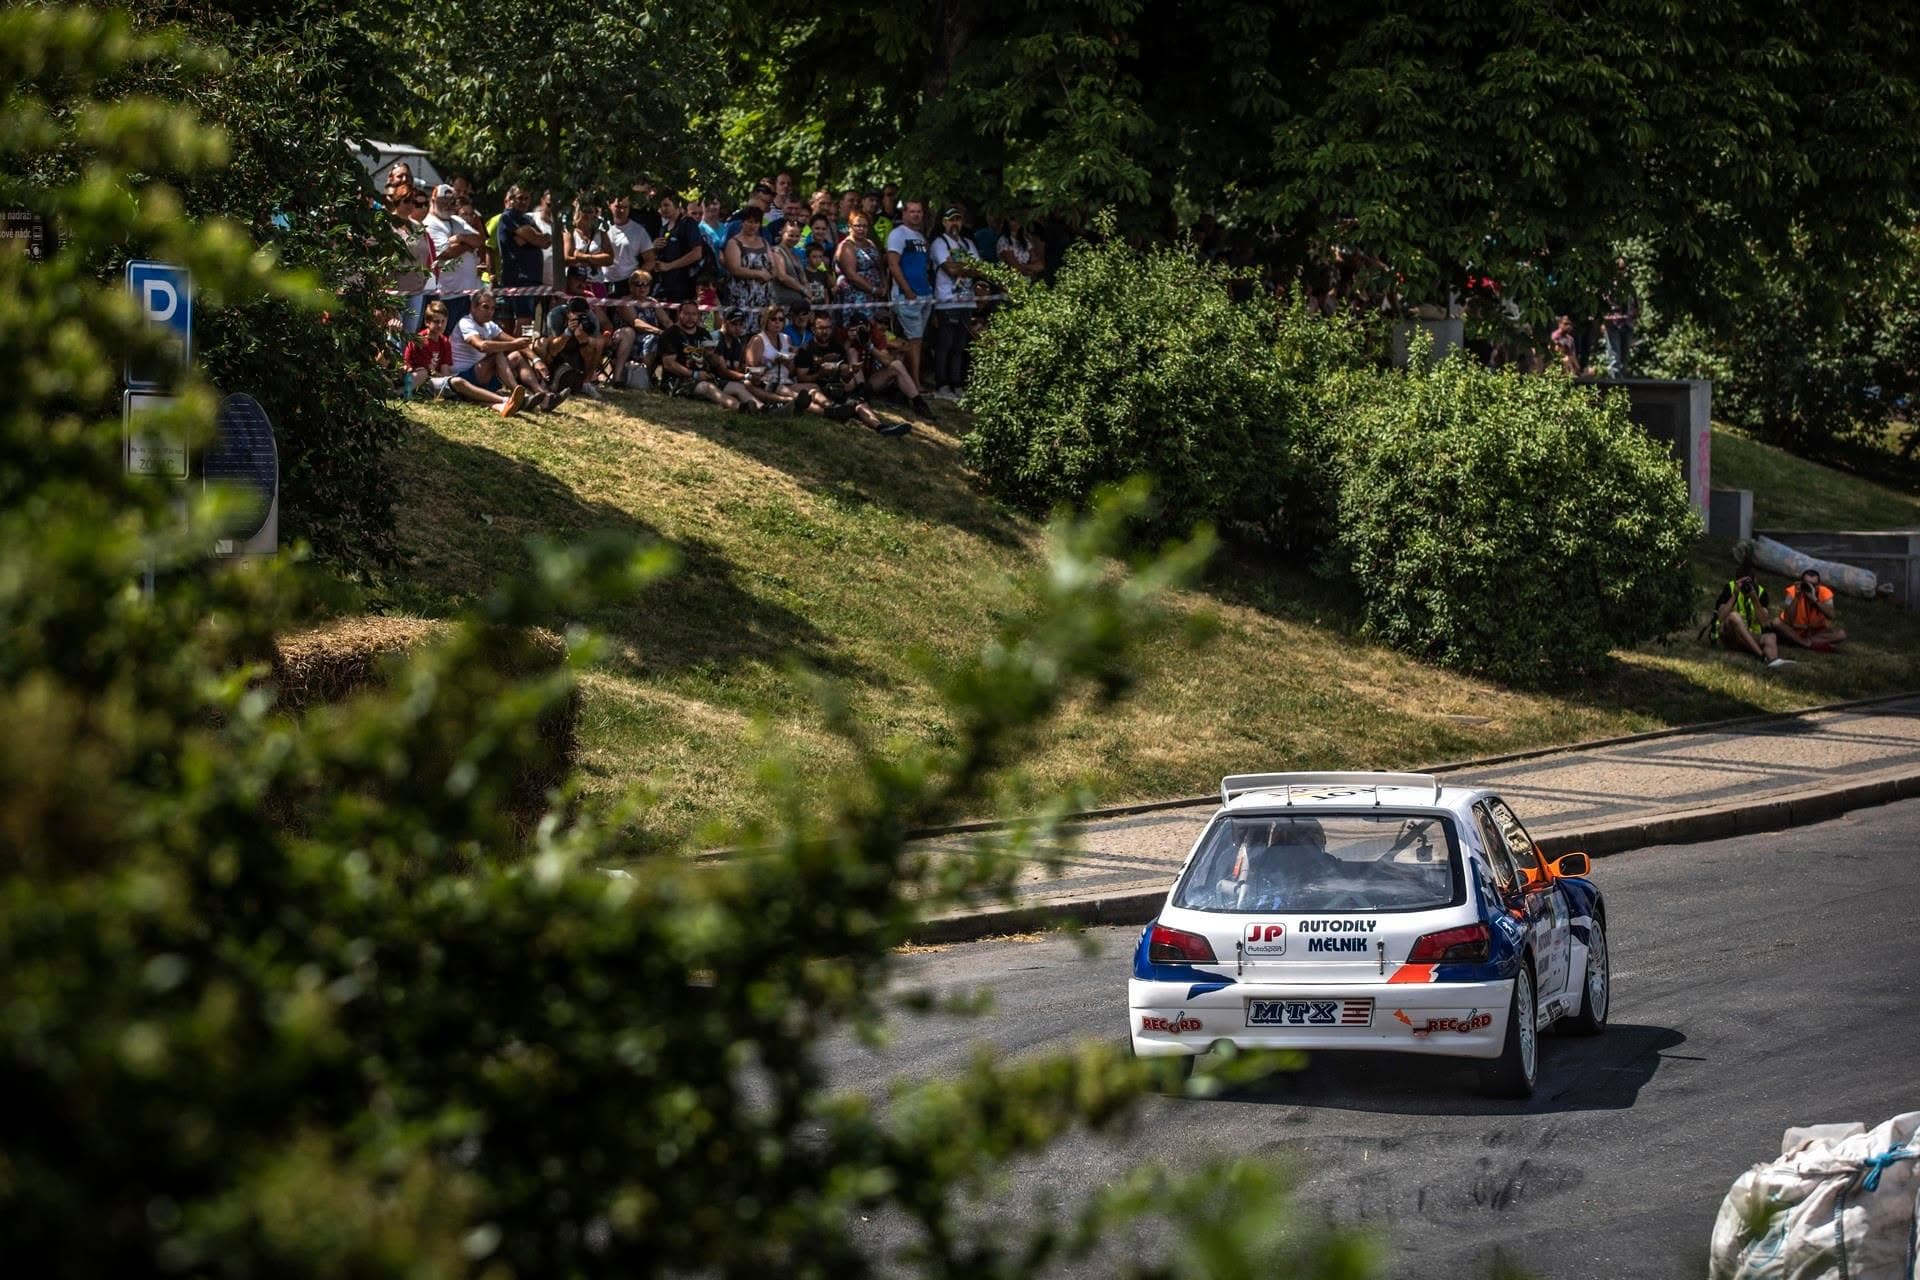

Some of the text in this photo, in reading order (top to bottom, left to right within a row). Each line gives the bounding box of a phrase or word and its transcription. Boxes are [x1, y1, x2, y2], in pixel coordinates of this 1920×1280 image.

[1248, 926, 1283, 942] JP
[1299, 919, 1377, 932] AUTODÍLY
[1308, 937, 1368, 952] MĚLNÍK
[1250, 1001, 1338, 1024] MTX
[1142, 1016, 1203, 1034] RECORD
[1426, 1013, 1494, 1034] RECORD
